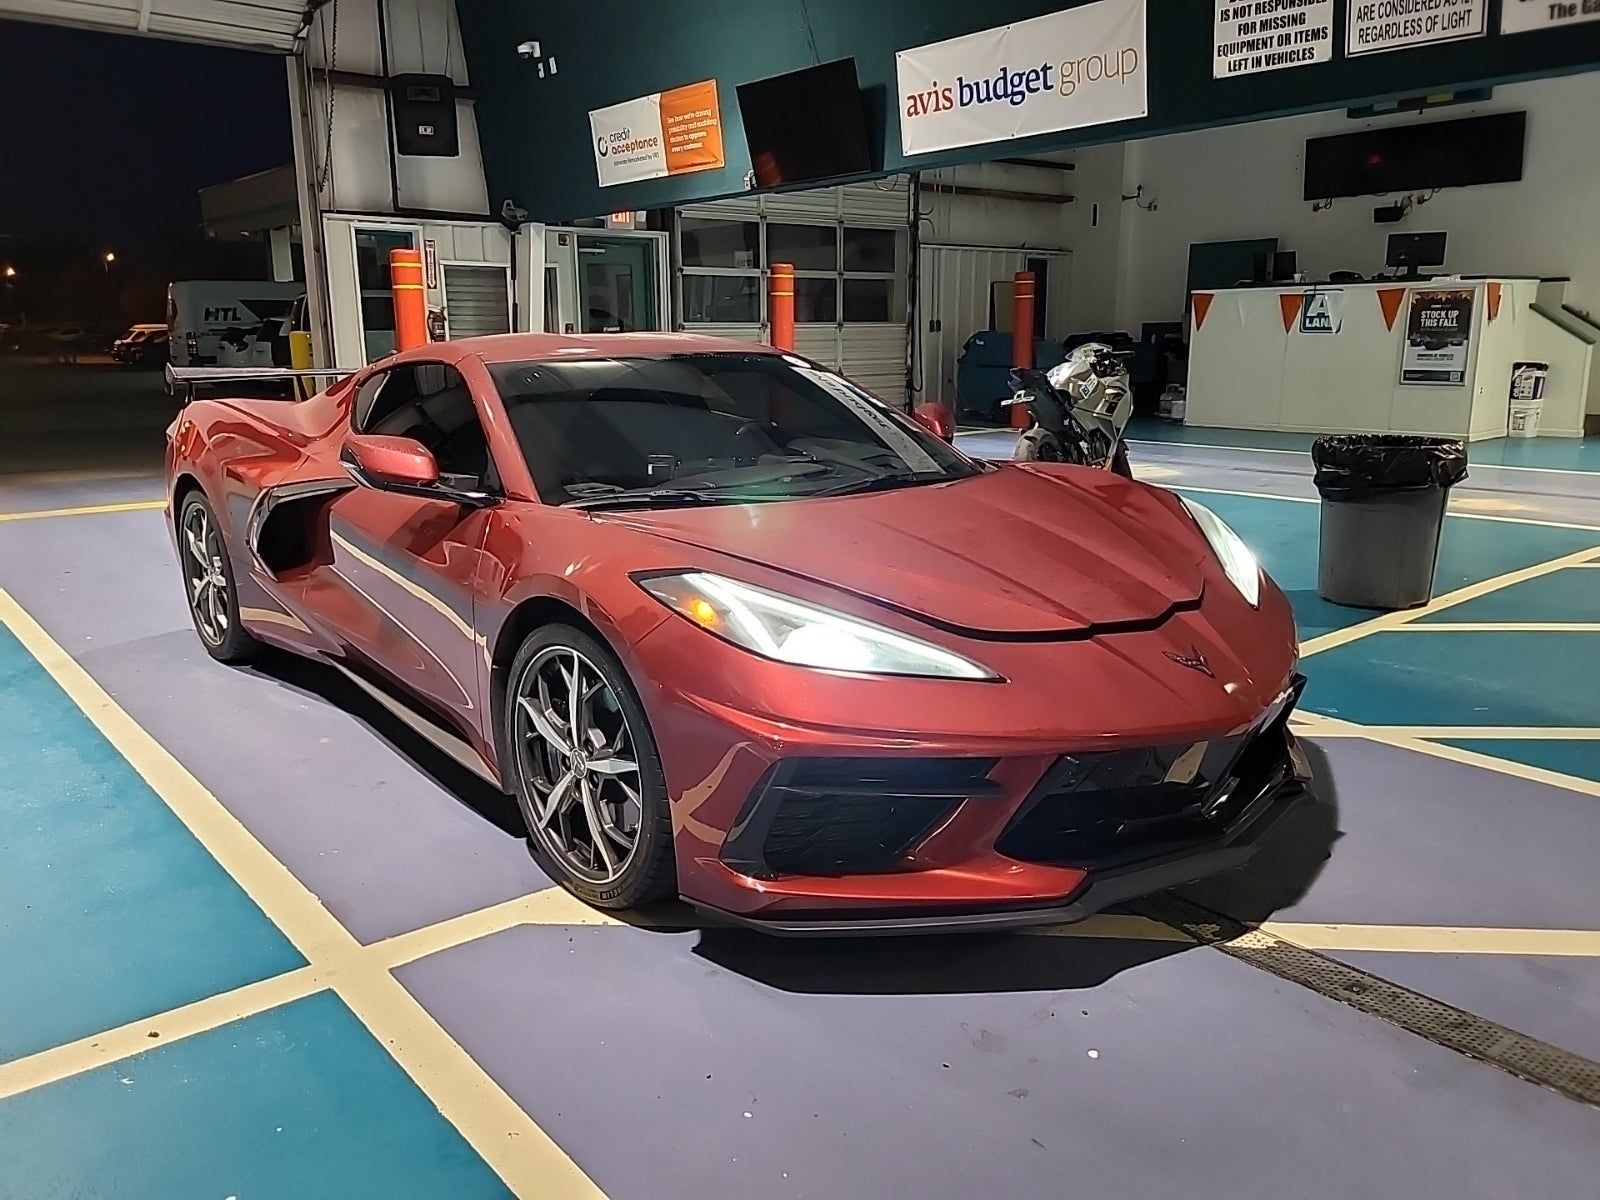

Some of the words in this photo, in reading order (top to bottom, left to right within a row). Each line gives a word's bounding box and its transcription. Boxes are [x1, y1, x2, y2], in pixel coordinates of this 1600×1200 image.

[1220, 9, 1230, 22] IS
[1232, 4, 1253, 20] NOT
[1255, 0, 1327, 15] RESPONSI
[1356, 3, 1375, 23] ARE
[1378, 0, 1443, 20] CONSIDERED
[1549, 3, 1577, 20] The
[1238, 22, 1256, 36] FOR
[1260, 12, 1306, 33] MISSING
[1358, 17, 1422, 44] REGARDLESS
[1425, 15, 1439, 33] OF
[1441, 9, 1472, 31] LIGHT
[1217, 36, 1275, 57] EQUIPMENT
[1277, 33, 1291, 47] OR
[1294, 26, 1328, 44] ITEMS
[1228, 58, 1249, 72] LEFT
[1251, 56, 1262, 69] IN
[1264, 47, 1315, 67] VEHICLES
[906, 80, 953, 117] avis
[957, 61, 1054, 106] budget
[1059, 47, 1138, 96] group
[609, 127, 630, 143] credit
[611, 137, 658, 154] acceptance
[1306, 294, 1330, 316] A
[1421, 310, 1446, 319] STOCK
[1448, 310, 1459, 318] UP
[1306, 317, 1331, 328] LAN
[1421, 319, 1438, 327] THIS
[1439, 319, 1458, 327] FALL
